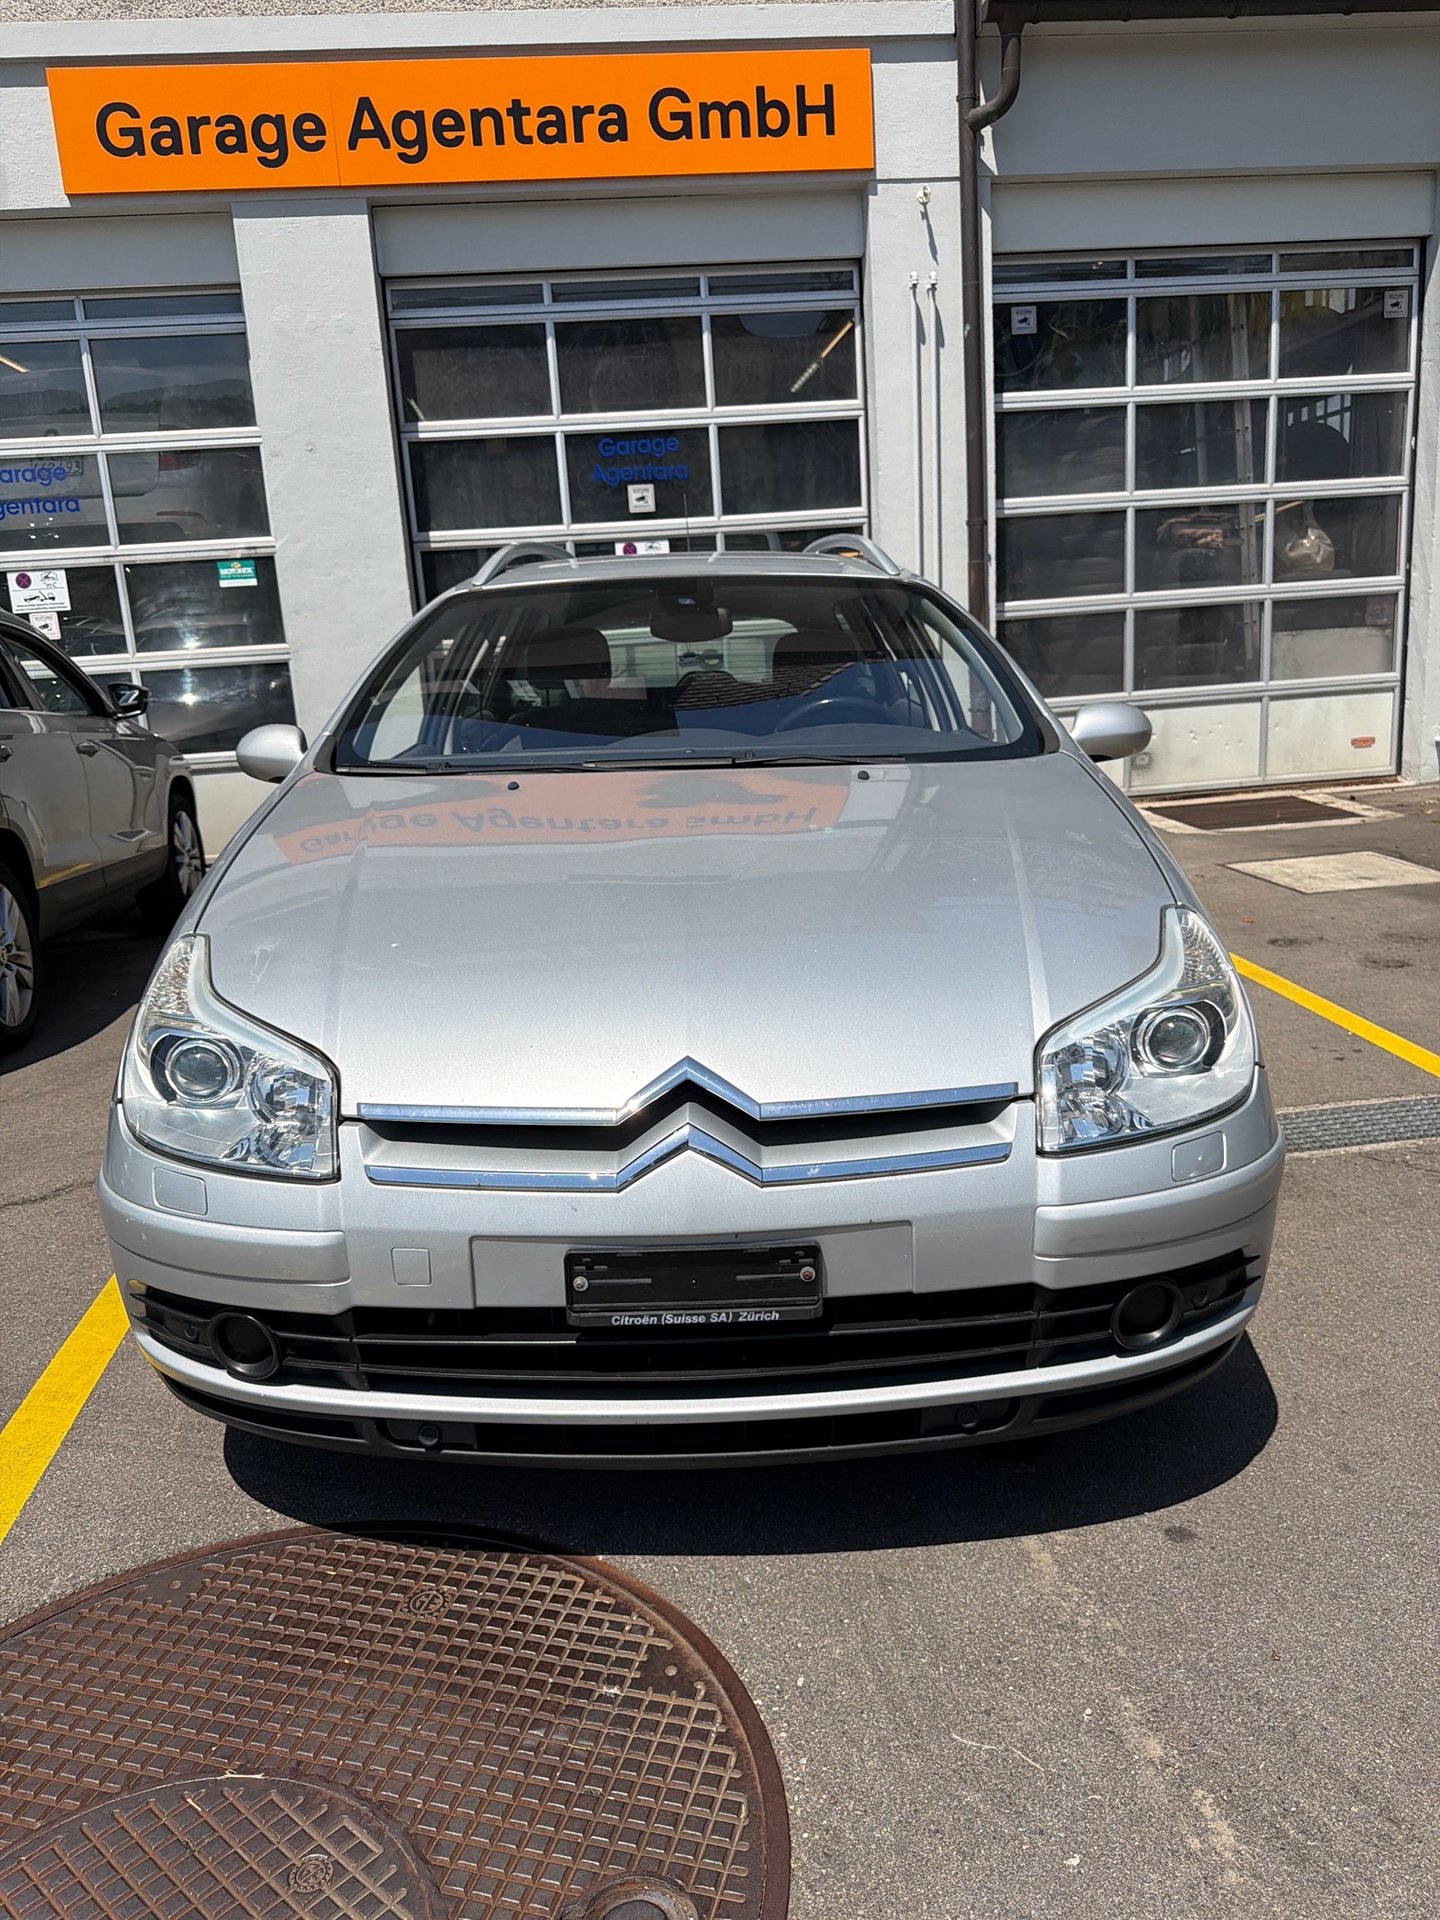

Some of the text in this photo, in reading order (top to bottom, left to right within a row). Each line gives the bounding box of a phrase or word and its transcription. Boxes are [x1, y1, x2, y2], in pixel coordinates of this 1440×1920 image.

[96, 84, 836, 169] Garage Agentara GmbH
[598, 436, 679, 458] Garage
[592, 462, 689, 486] Agentara
[611, 1311, 780, 1326] Citroën (Suisse SA) Zürich
